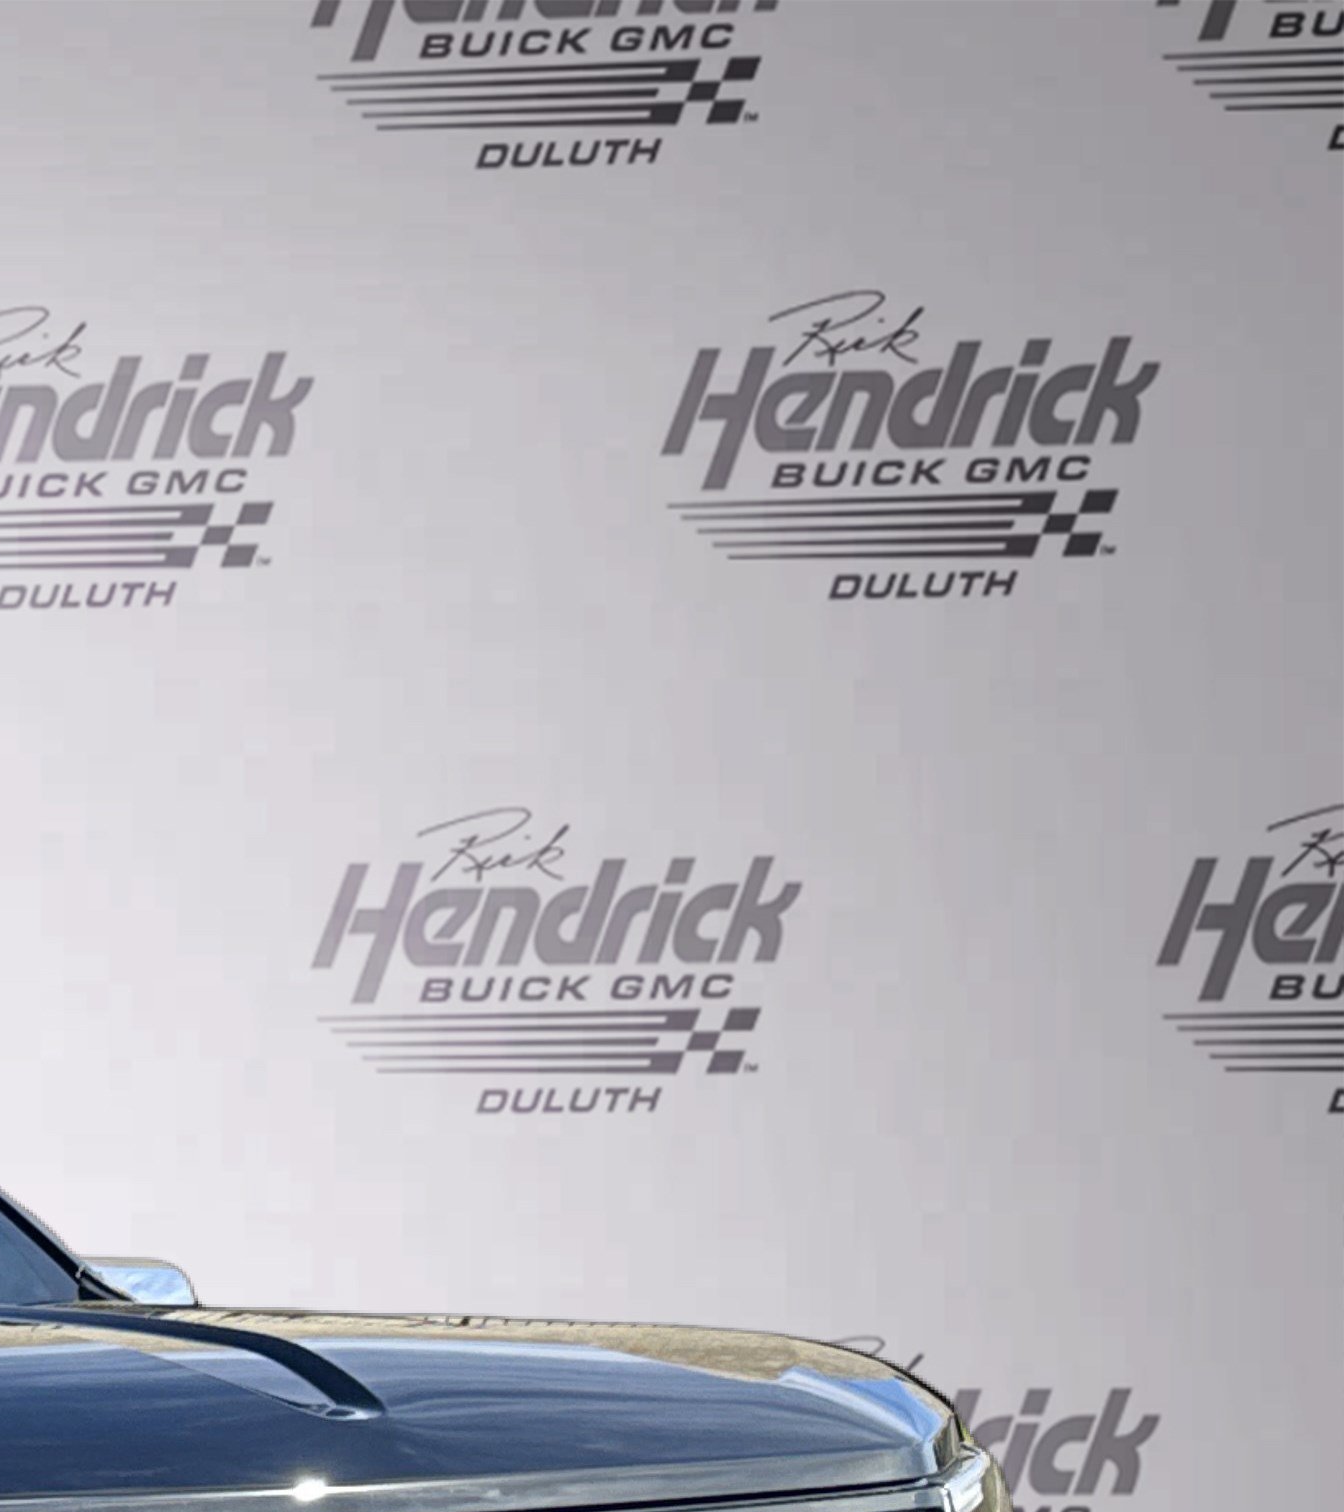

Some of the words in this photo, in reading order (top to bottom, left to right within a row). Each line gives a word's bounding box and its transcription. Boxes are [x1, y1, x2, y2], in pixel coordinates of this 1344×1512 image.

[418, 27, 593, 60] BUICK
[609, 22, 735, 53] GMC
[475, 137, 663, 170] DULUTH
[660, 335, 1161, 492] Hendrick
[126, 468, 248, 496] GMC
[770, 457, 947, 489] BUICK
[964, 454, 1092, 484] GMC
[828, 569, 1019, 601] DULUTH
[311, 855, 803, 1004] Hendrick
[419, 975, 591, 1003] BUICK
[610, 973, 735, 1001] GMC
[476, 1086, 663, 1114] DULUTH
